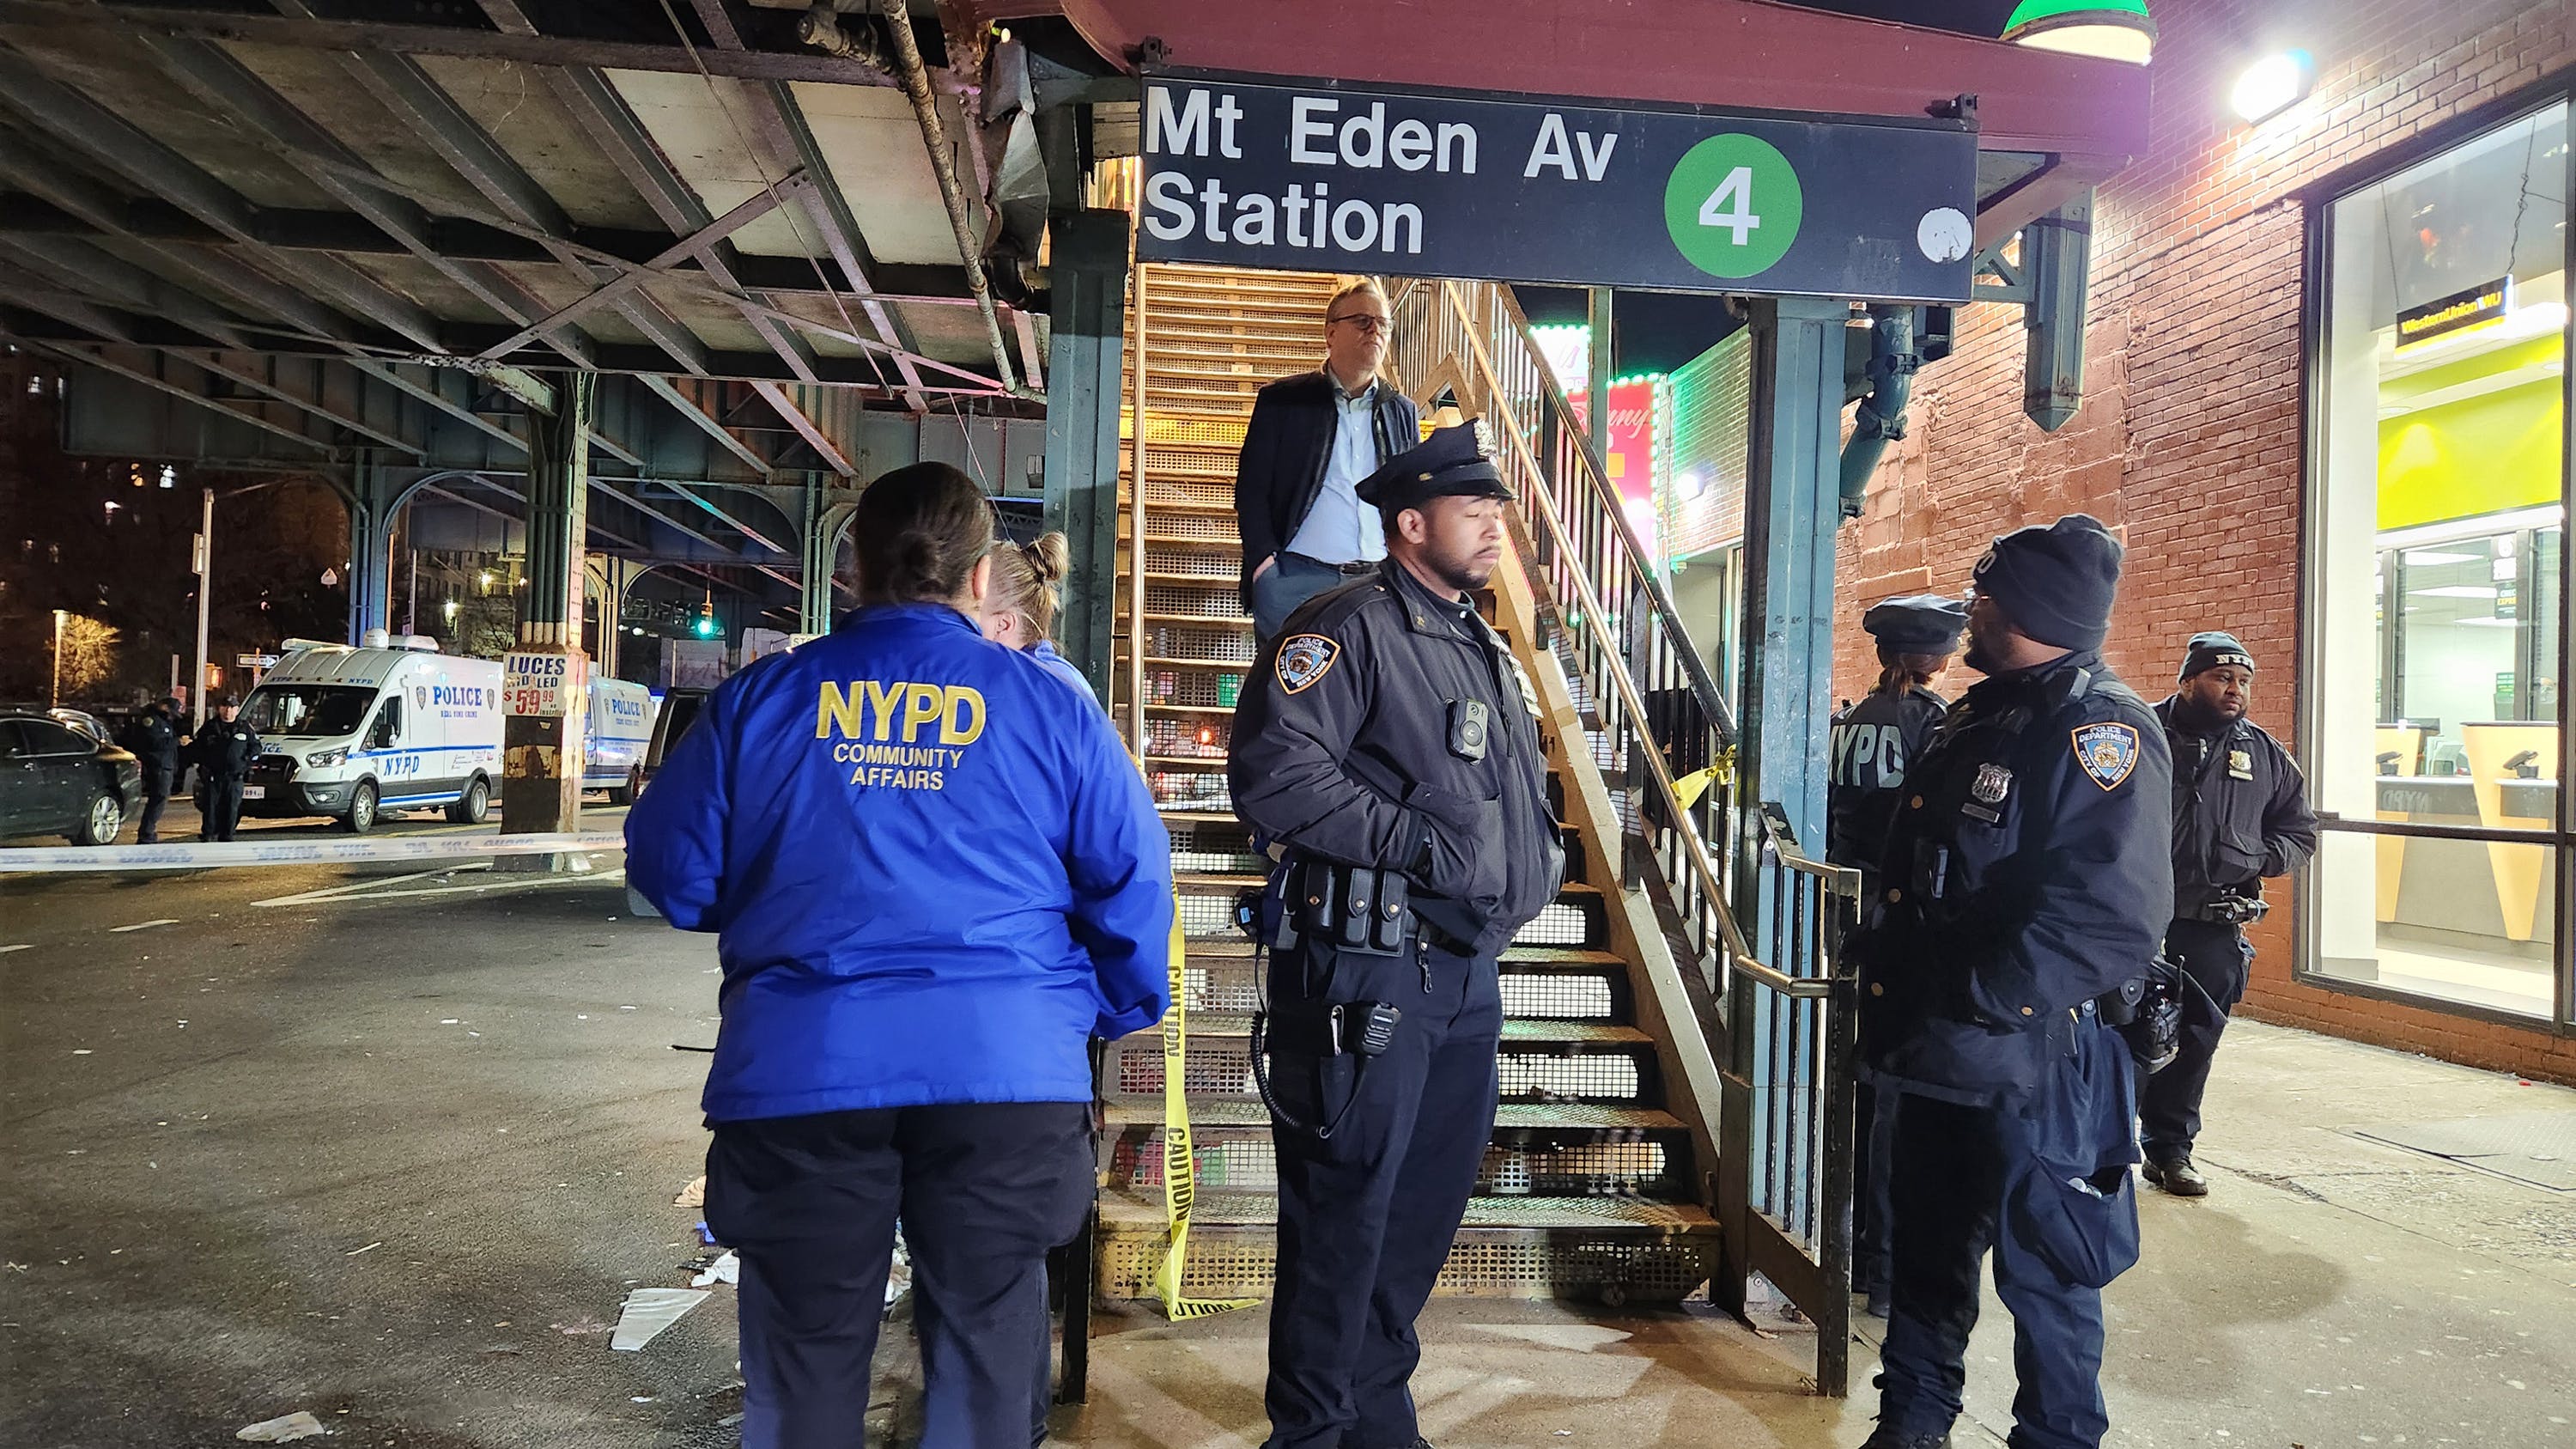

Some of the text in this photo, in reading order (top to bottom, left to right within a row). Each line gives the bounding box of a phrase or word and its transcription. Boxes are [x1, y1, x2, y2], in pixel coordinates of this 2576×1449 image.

[1145, 85, 1619, 181] Mt Eden Av
[1144, 171, 1423, 254] Station
[1698, 166, 1760, 246] 4
[508, 656, 566, 675] LUCES
[1310, 660, 1328, 678] YORK
[537, 677, 558, 688] LED
[433, 685, 482, 706] POLICE
[611, 698, 641, 716] POLICE
[816, 680, 987, 746] NYPD
[2079, 732, 2133, 745] DEPARTMENT
[384, 756, 420, 776] NYPD
[833, 743, 965, 769] COMMUNITY
[2080, 750, 2101, 778] CITY OF
[850, 767, 945, 790] AFFAIRS
[1168, 1127, 1192, 1221] CAUTION
[1175, 1301, 1235, 1317] UTION
